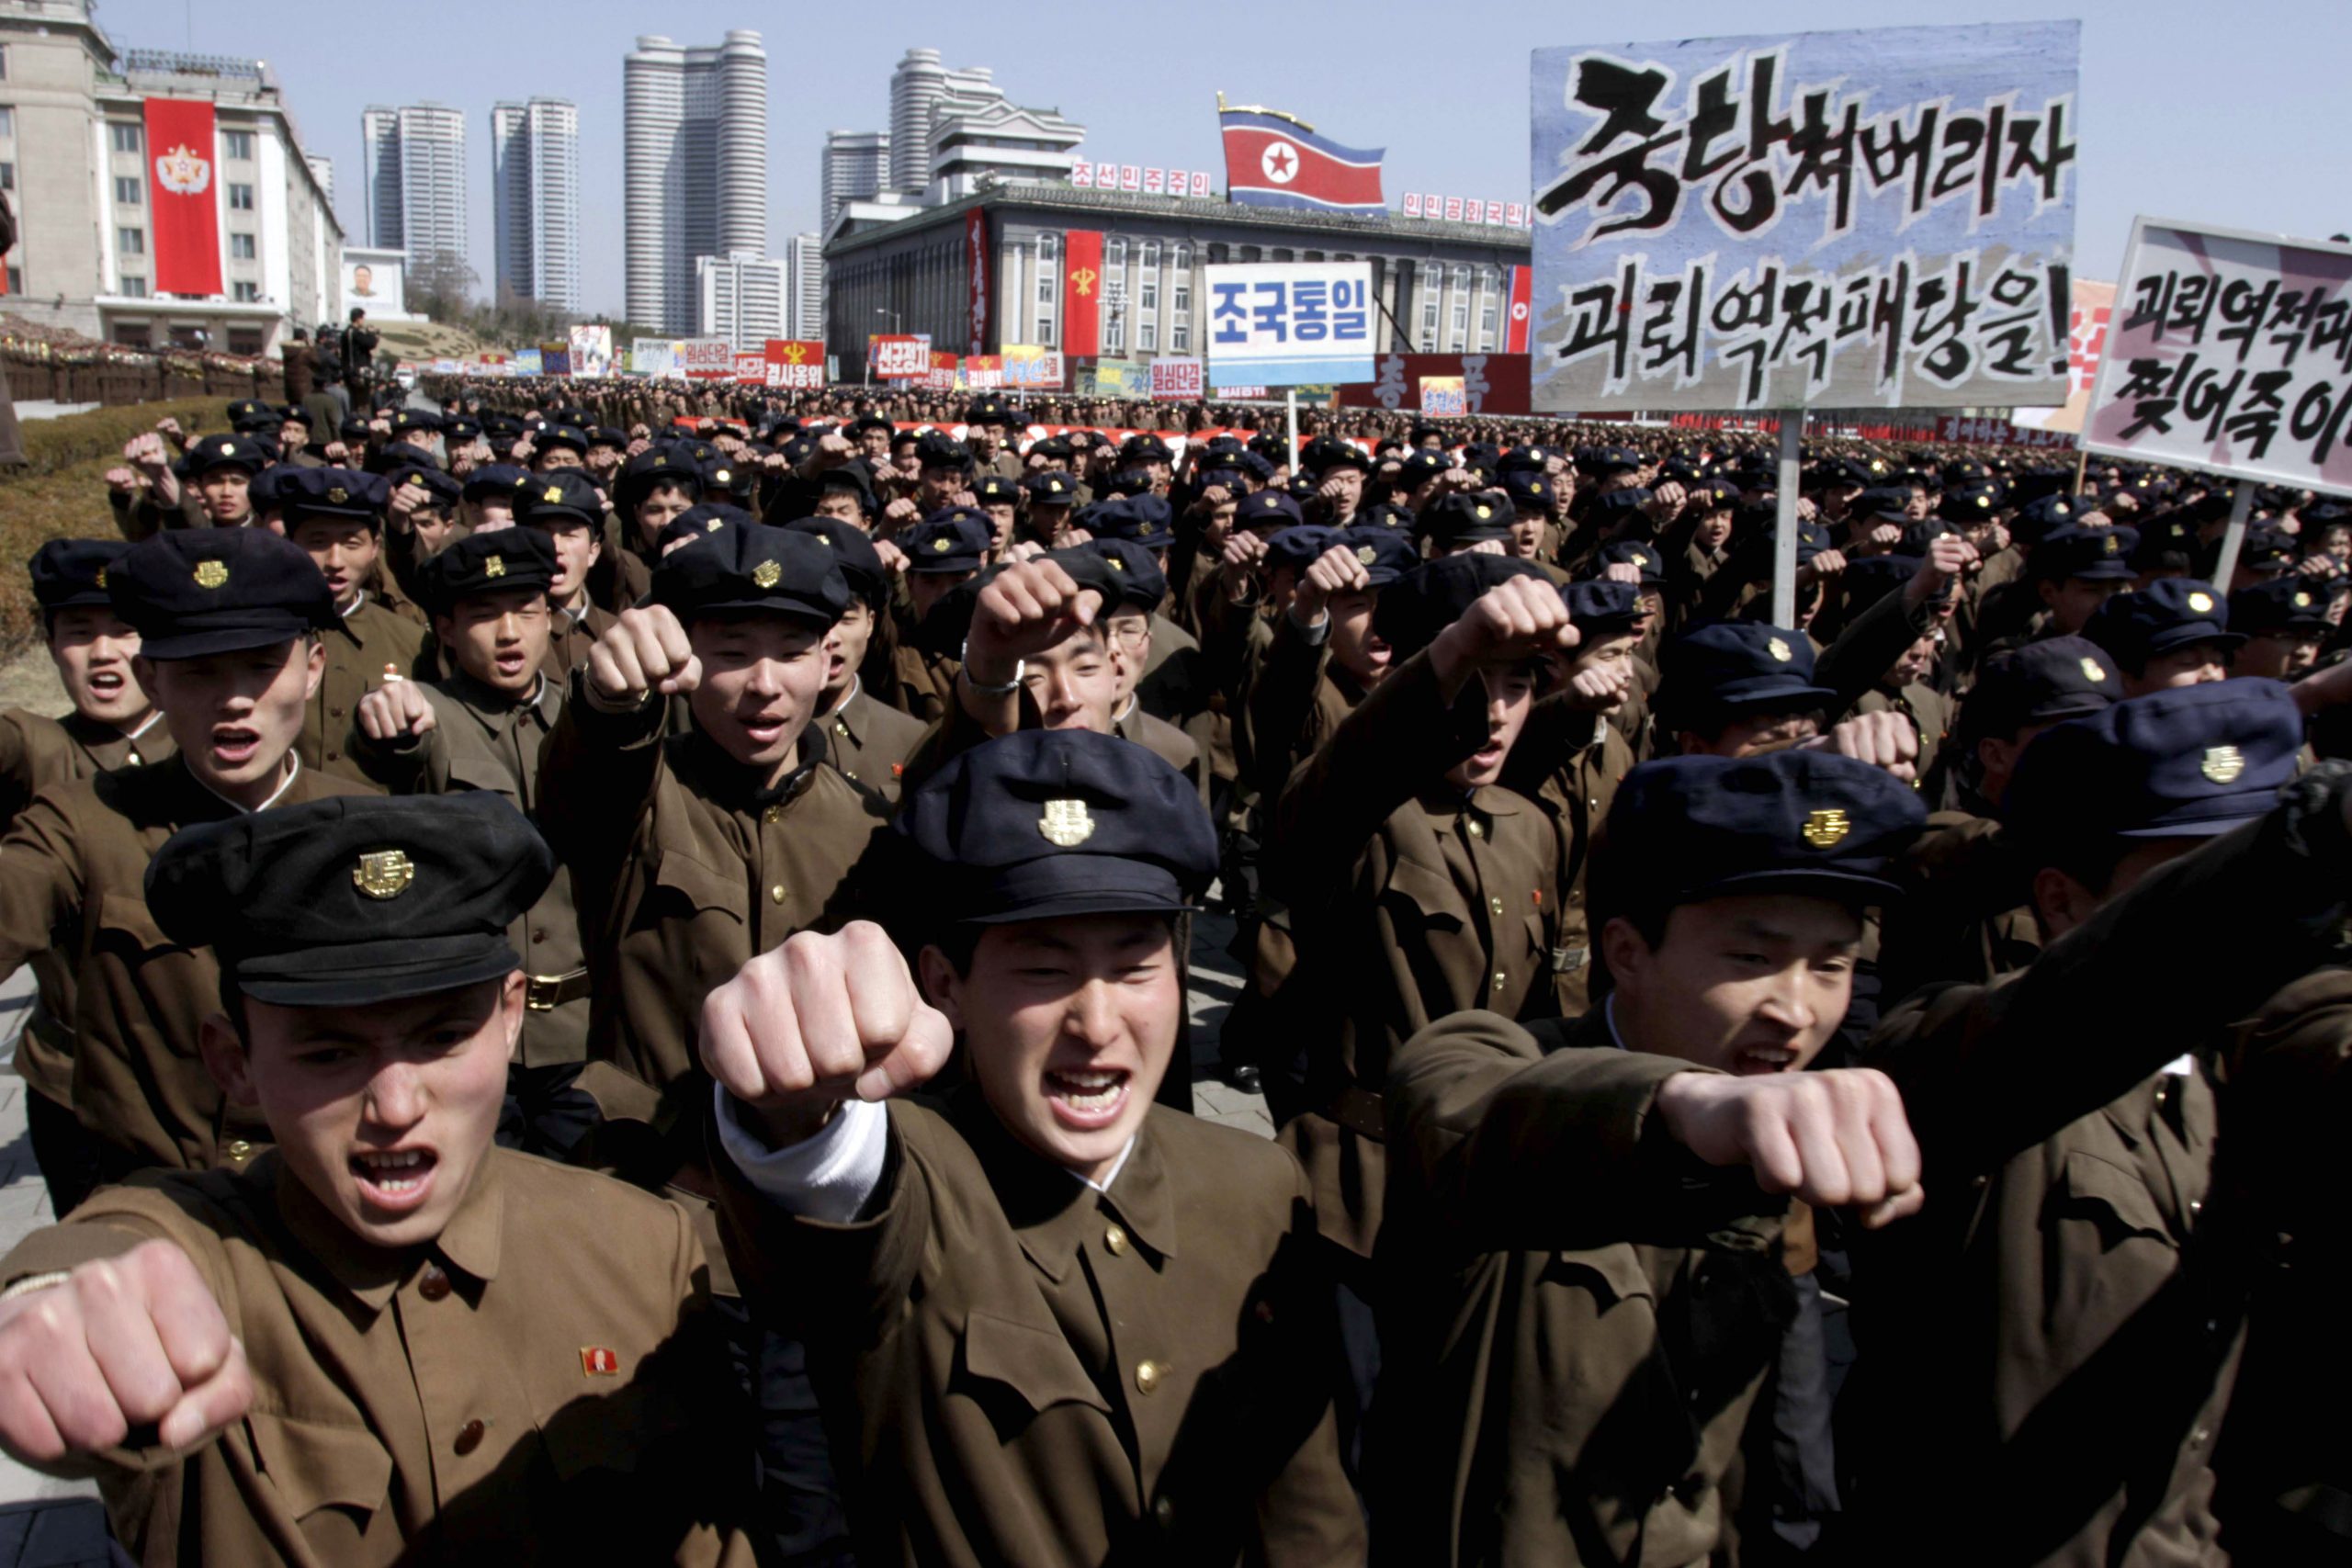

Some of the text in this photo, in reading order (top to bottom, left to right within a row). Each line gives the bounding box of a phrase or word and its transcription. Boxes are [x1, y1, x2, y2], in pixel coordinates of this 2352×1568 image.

[1075, 163, 1532, 225] 조선민주주의 인민공화국만
[1213, 279, 1367, 344] 조국통일
[1558, 261, 2070, 404] 괴뢰역적패당을!
[685, 343, 729, 365] 일심단결
[878, 341, 930, 375] 선군정치
[766, 363, 823, 389] 결사옹위
[1152, 362, 1200, 391] 일심단결
[1424, 389, 1463, 412] 총결산
[2114, 352, 2352, 465] 찢어죽이
